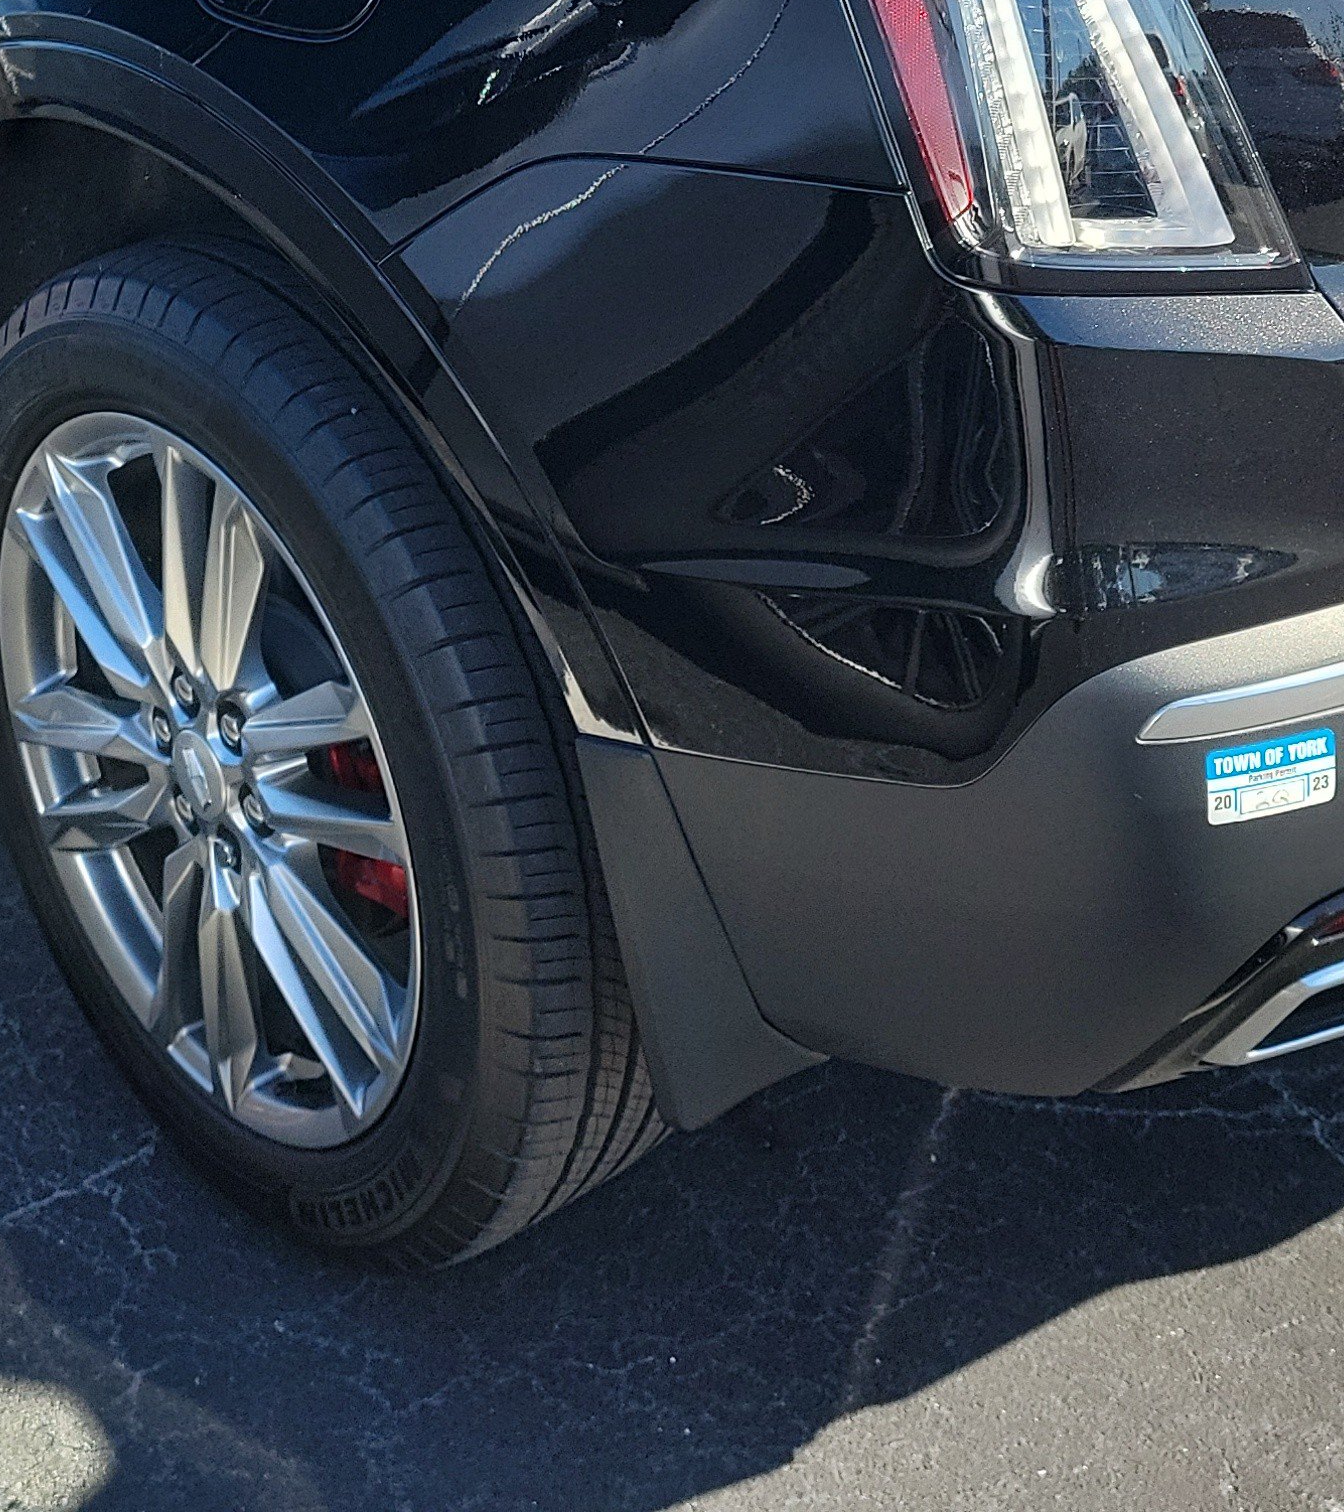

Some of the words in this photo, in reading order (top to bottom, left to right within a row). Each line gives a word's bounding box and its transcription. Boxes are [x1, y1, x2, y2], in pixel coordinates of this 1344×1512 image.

[1213, 751, 1261, 775] TOWN
[1264, 747, 1284, 766] OF
[1287, 736, 1329, 761] YORK
[1214, 794, 1232, 811] 20
[1313, 774, 1329, 791] 23
